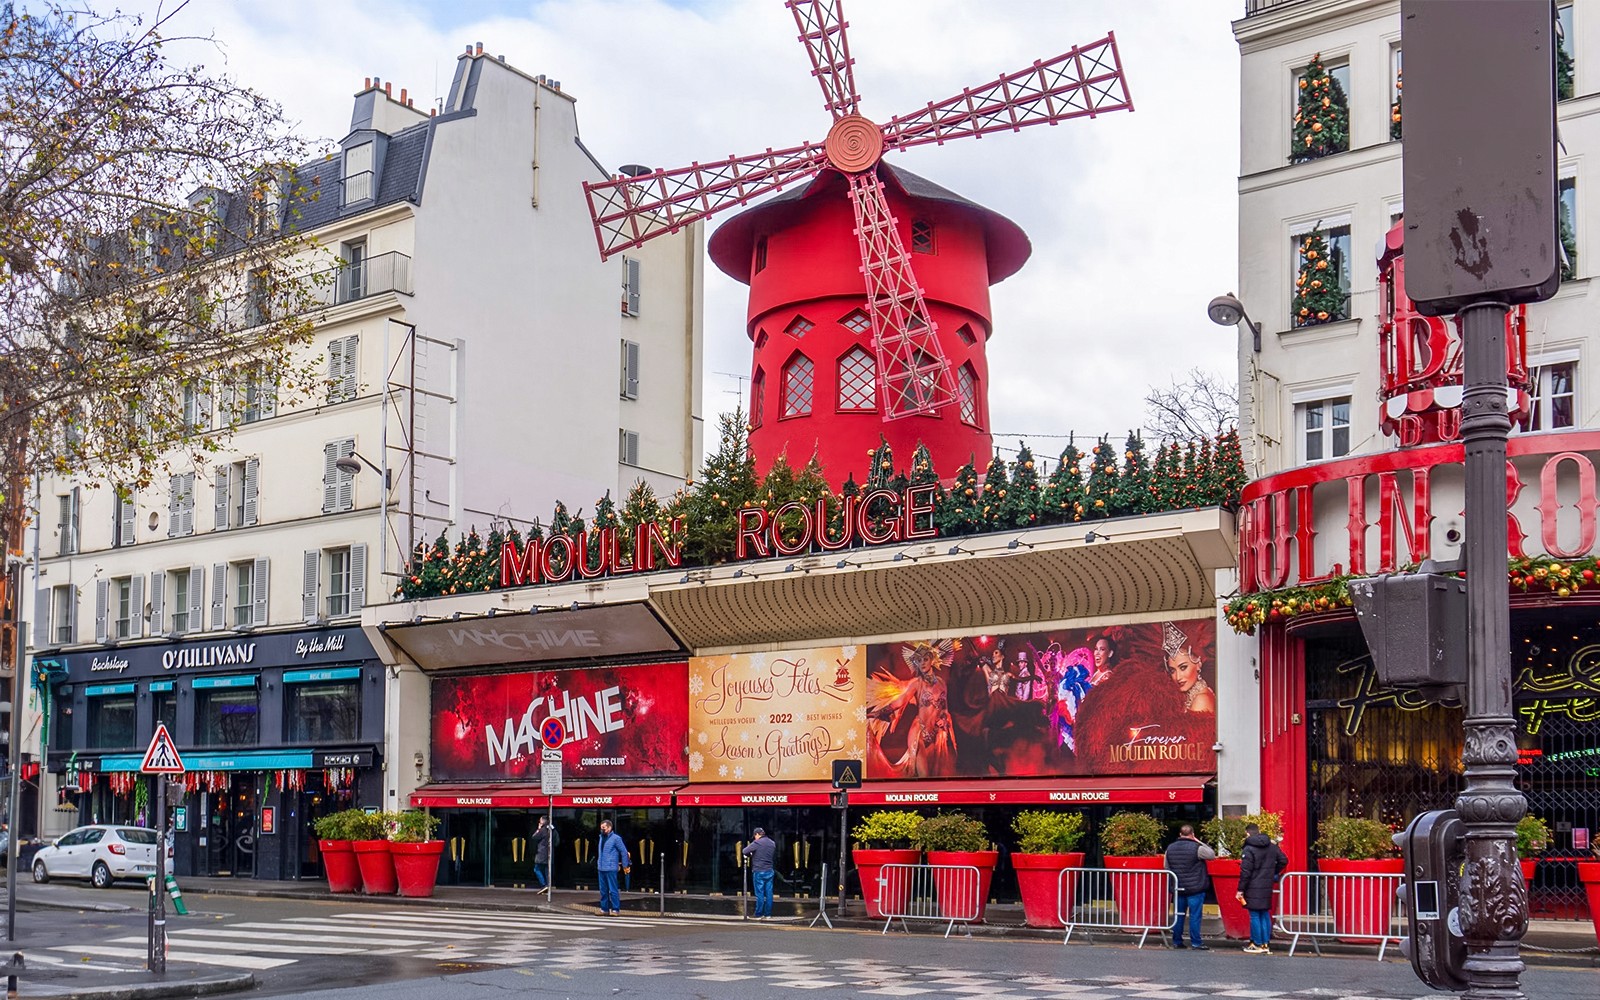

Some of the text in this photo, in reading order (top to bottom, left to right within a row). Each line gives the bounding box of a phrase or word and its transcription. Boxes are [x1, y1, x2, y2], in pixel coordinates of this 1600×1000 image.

[500, 481, 939, 588] MOULIN ROUGE
[162, 643, 256, 670] O'SULLIVANS
[295, 634, 345, 659] By the Mill
[91, 655, 129, 673] Backstage
[695, 662, 775, 716] Joyeuses
[485, 685, 625, 767] MACHINE
[769, 713, 793, 724] 2022
[821, 712, 843, 721] WISHES
[707, 725, 763, 761] Season's
[1123, 724, 1187, 751] Forever
[581, 757, 625, 766] CONCERTS CLUB
[1109, 741, 1204, 763] MOULIN ROUGE
[741, 795, 788, 803] MOULIN ROUGE
[885, 793, 939, 802] MOULIN ROUGE
[1049, 792, 1110, 800] MOULIN ROUGE
